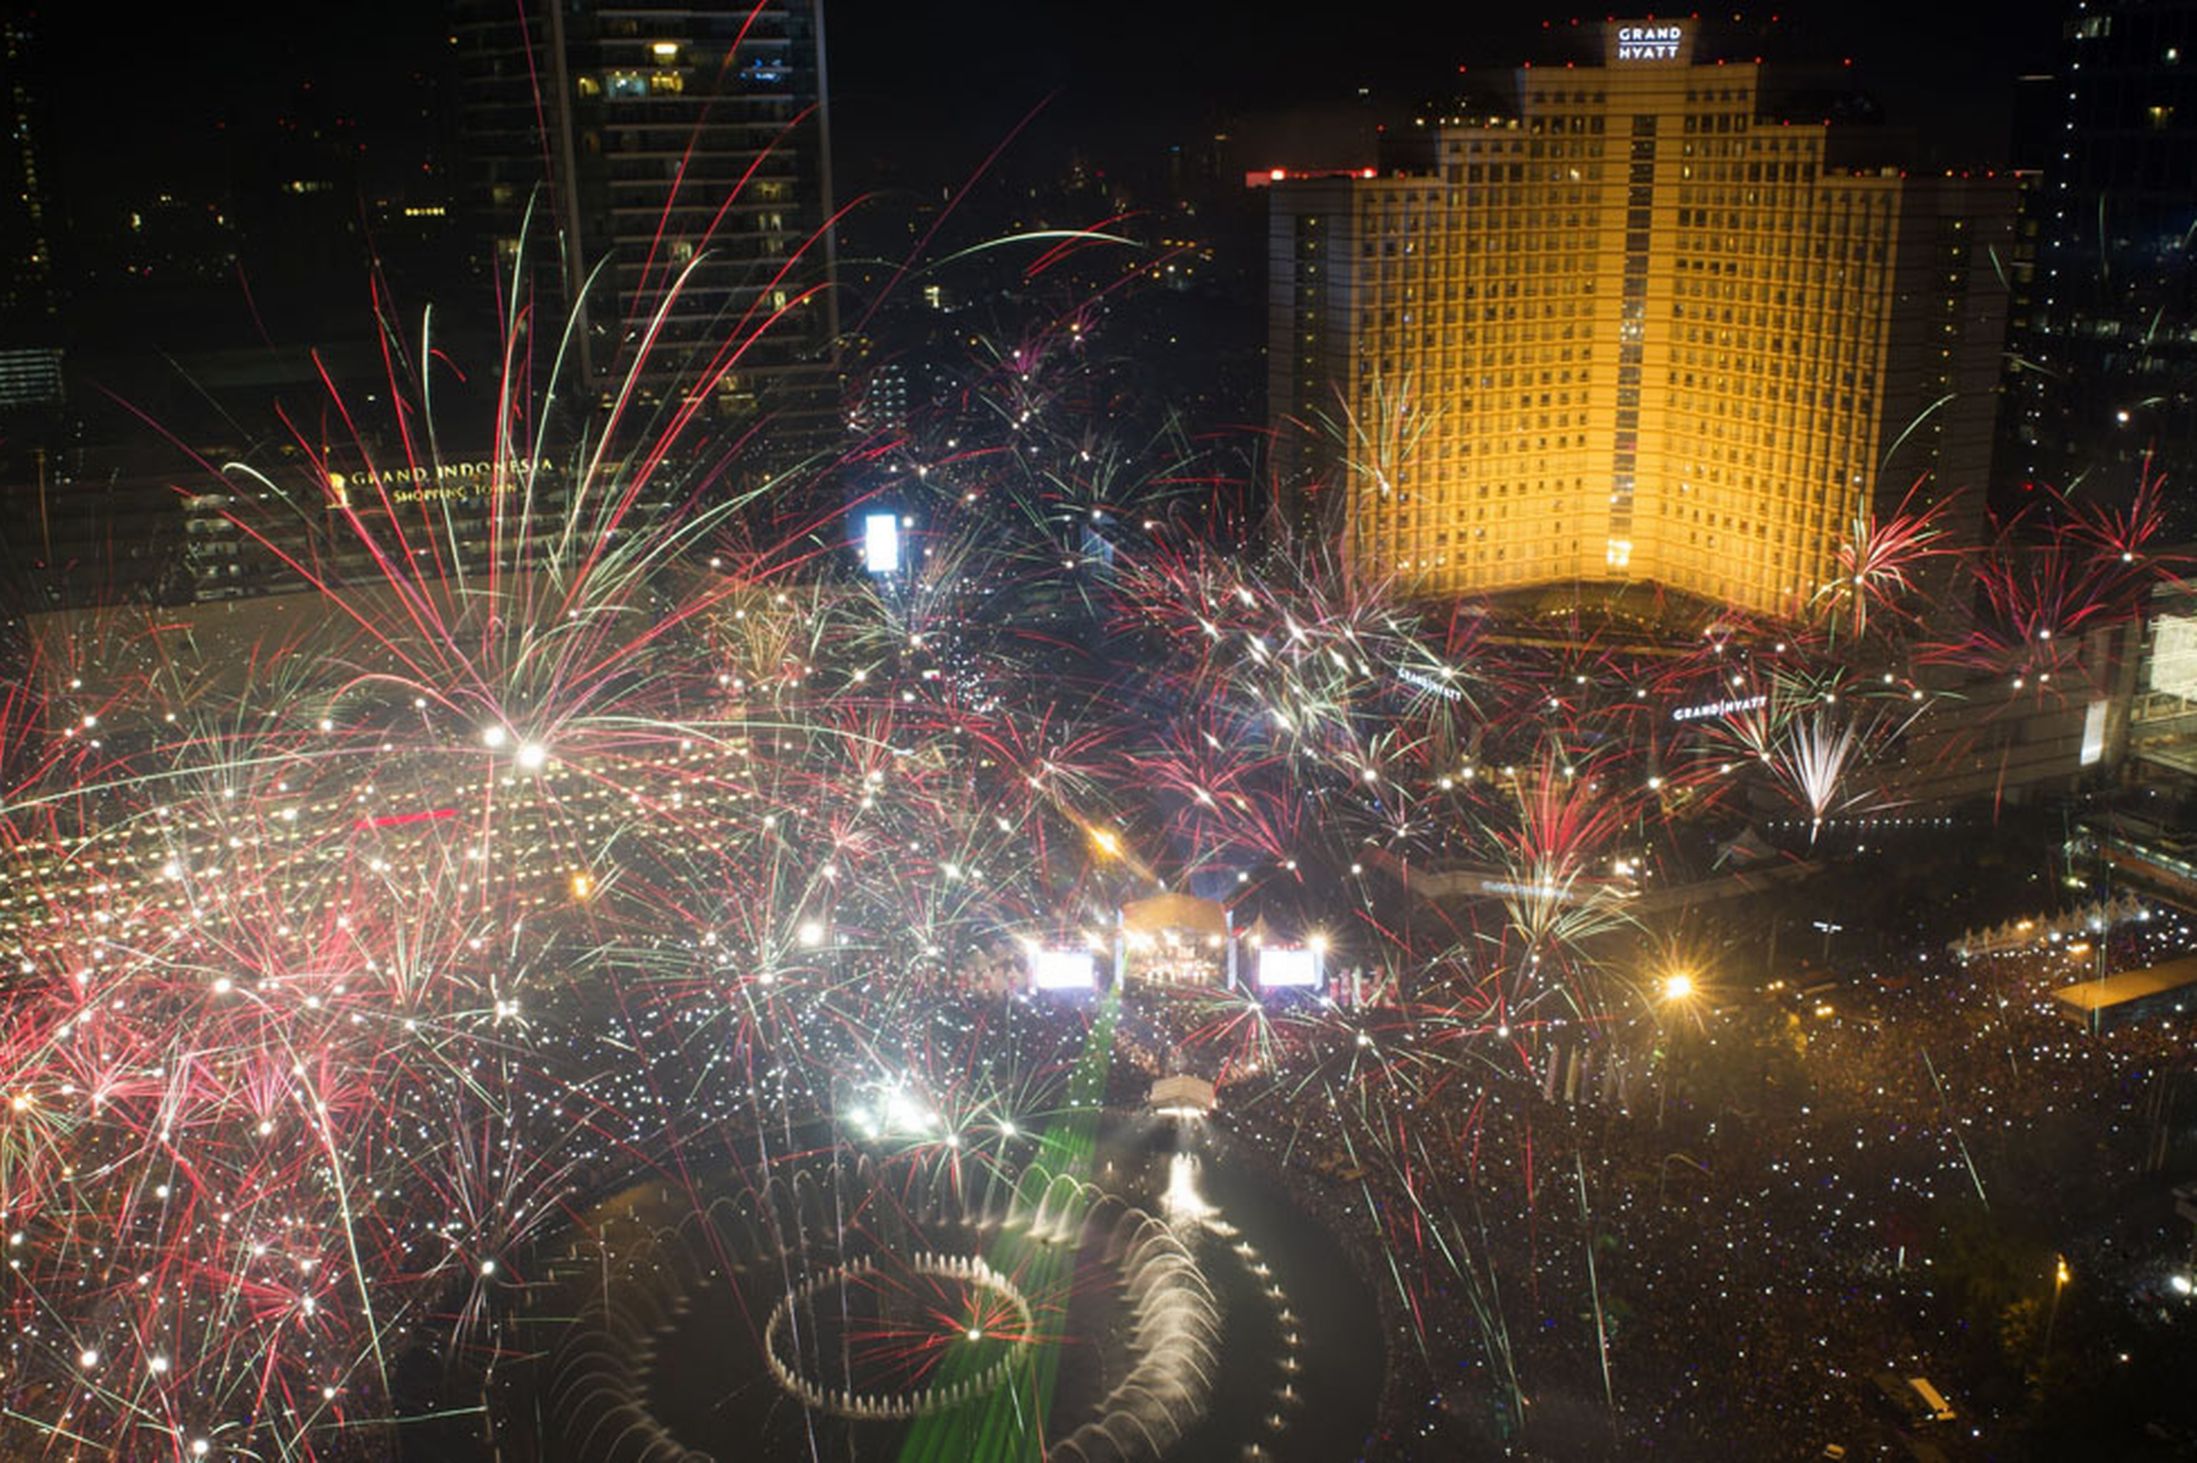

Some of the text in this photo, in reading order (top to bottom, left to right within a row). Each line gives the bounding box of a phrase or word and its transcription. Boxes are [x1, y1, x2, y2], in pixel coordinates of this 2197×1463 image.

[1618, 26, 1682, 41] GRAND
[1619, 46, 1679, 60] HYATT
[436, 457, 553, 479] INDONESA
[473, 482, 517, 496] TON
[1672, 695, 1767, 721] GRAND HYATT
